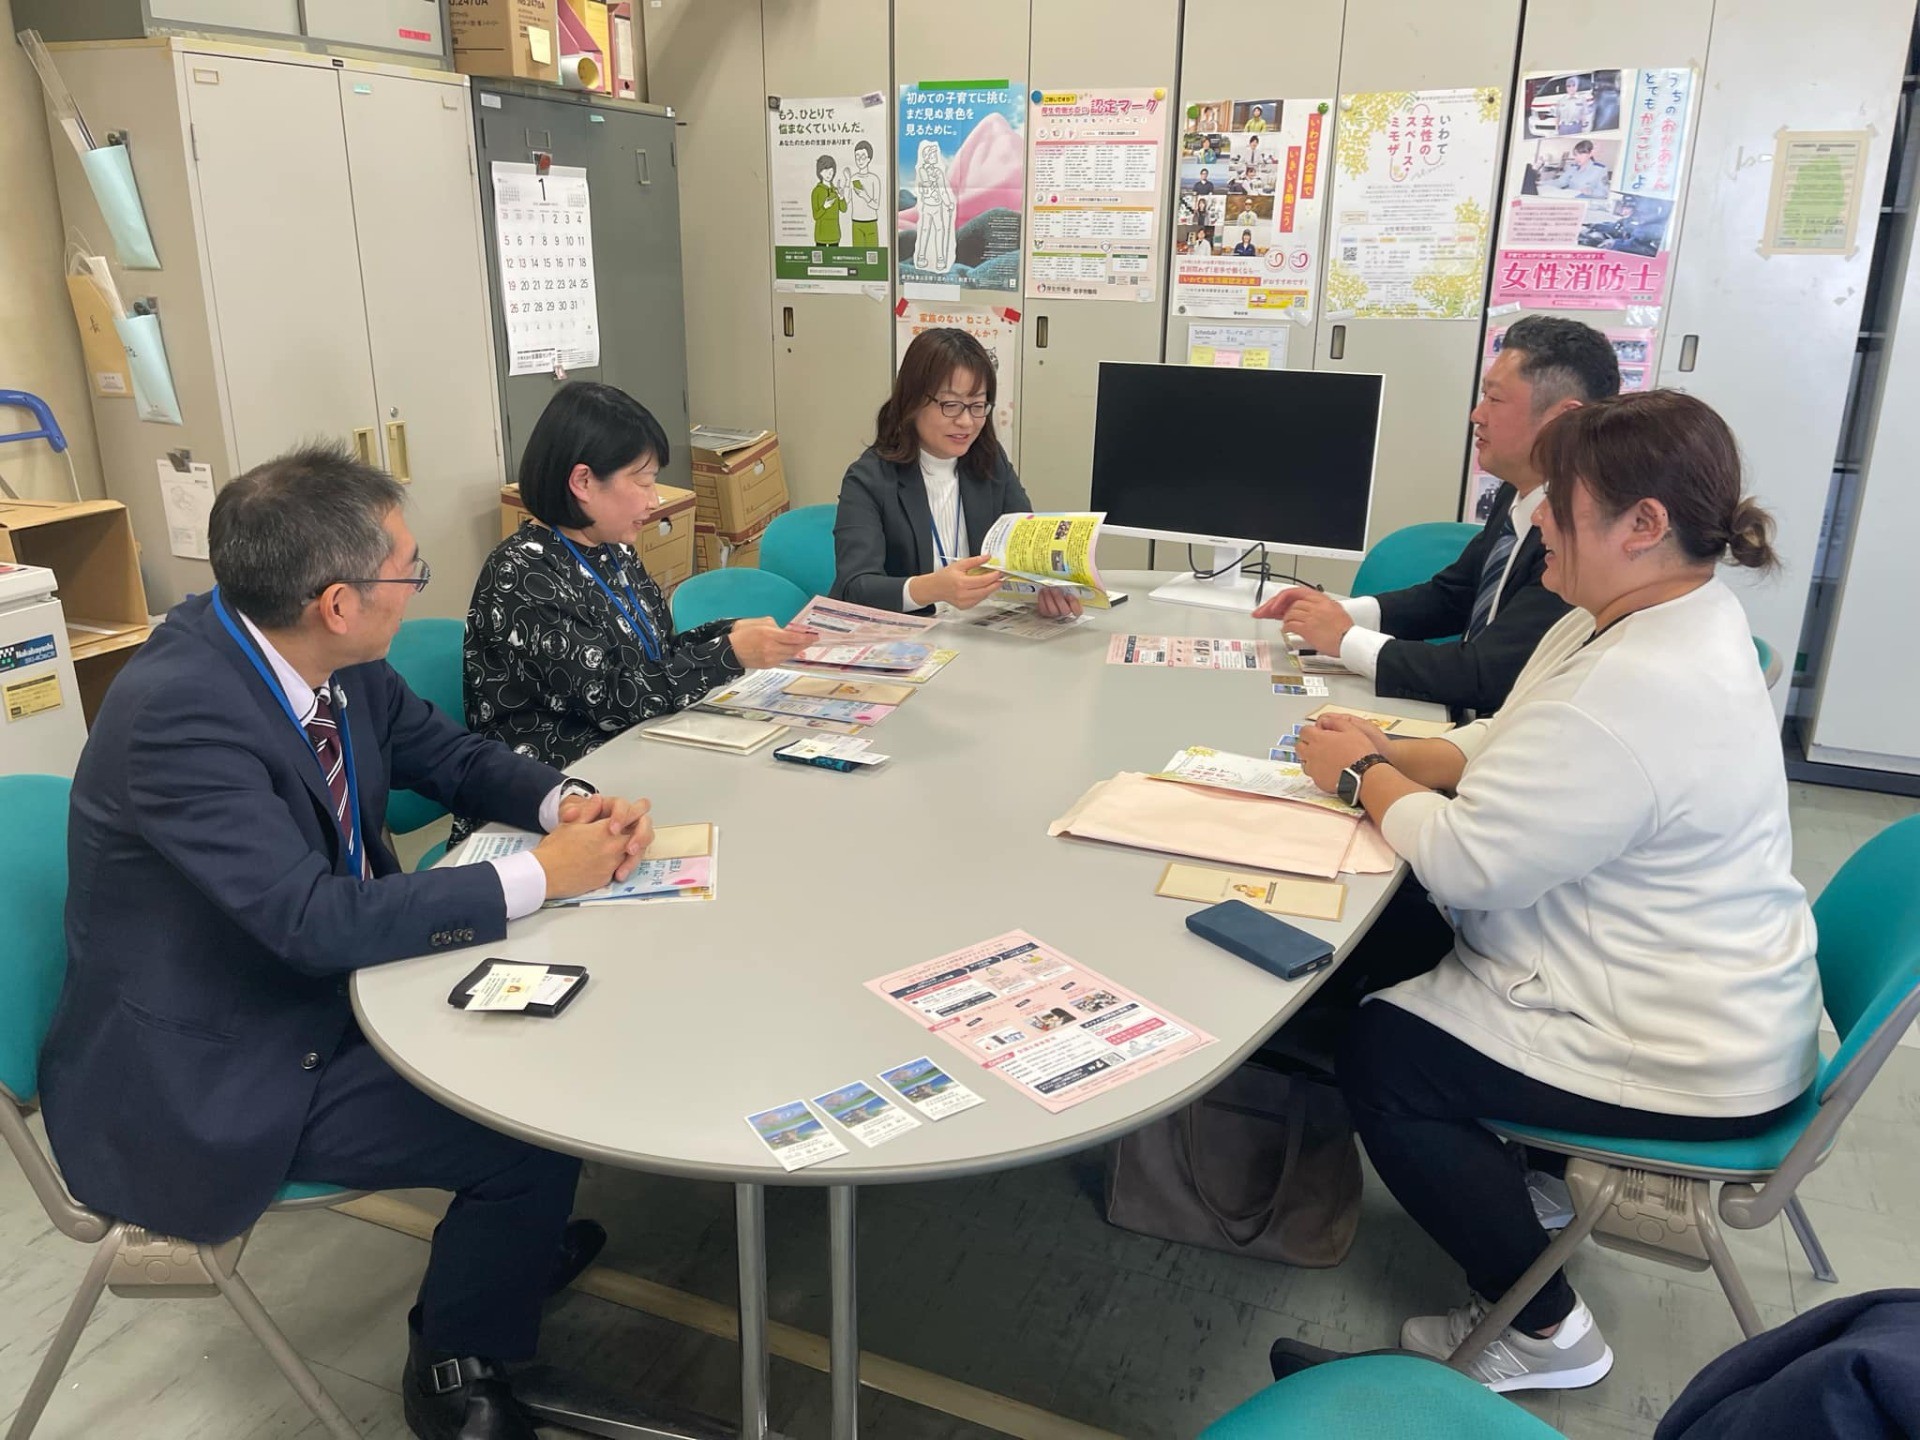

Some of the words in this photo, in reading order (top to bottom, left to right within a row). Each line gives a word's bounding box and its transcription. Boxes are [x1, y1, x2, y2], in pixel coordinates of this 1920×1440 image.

[906, 91, 1011, 105] 初めての子育てに挑む。
[1090, 98, 1159, 115] 認定マーク
[779, 108, 834, 120] もう、ひとりで
[906, 107, 974, 120] まだ見ぬ景色を
[779, 122, 864, 134] 悩まなくていいんだ。
[905, 124, 957, 136] 見るために。
[1387, 116, 1401, 156] ミモザ
[1419, 115, 1435, 156] 女性の
[1437, 115, 1451, 155] いわて
[538, 177, 546, 201] 1
[553, 214, 558, 224] 2
[565, 214, 570, 224] 3
[504, 235, 510, 246] 5
[517, 235, 522, 246] 6
[530, 235, 535, 246] 7
[542, 235, 547, 246] 8
[555, 235, 560, 246] 9
[566, 235, 574, 246] 10
[577, 236, 585, 246] 11
[506, 258, 513, 268] 12
[519, 258, 526, 268] 13
[531, 258, 538, 268] 14
[543, 258, 551, 268] 15
[556, 258, 563, 267] 16
[568, 258, 574, 267] 17
[579, 258, 586, 267] 18
[1501, 262, 1659, 291] 女性消防士
[508, 281, 516, 291] 19
[521, 281, 530, 291] 20
[533, 280, 540, 290] 21
[545, 280, 554, 290] 22
[557, 279, 565, 289] 23
[569, 279, 577, 289] 24
[581, 279, 588, 288] 25
[510, 303, 519, 313] 26
[522, 303, 530, 312] 27
[534, 302, 543, 312] 28
[546, 301, 555, 311] 29
[558, 301, 567, 310] 30
[570, 300, 577, 309] 31
[919, 313, 963, 324] 家族のない
